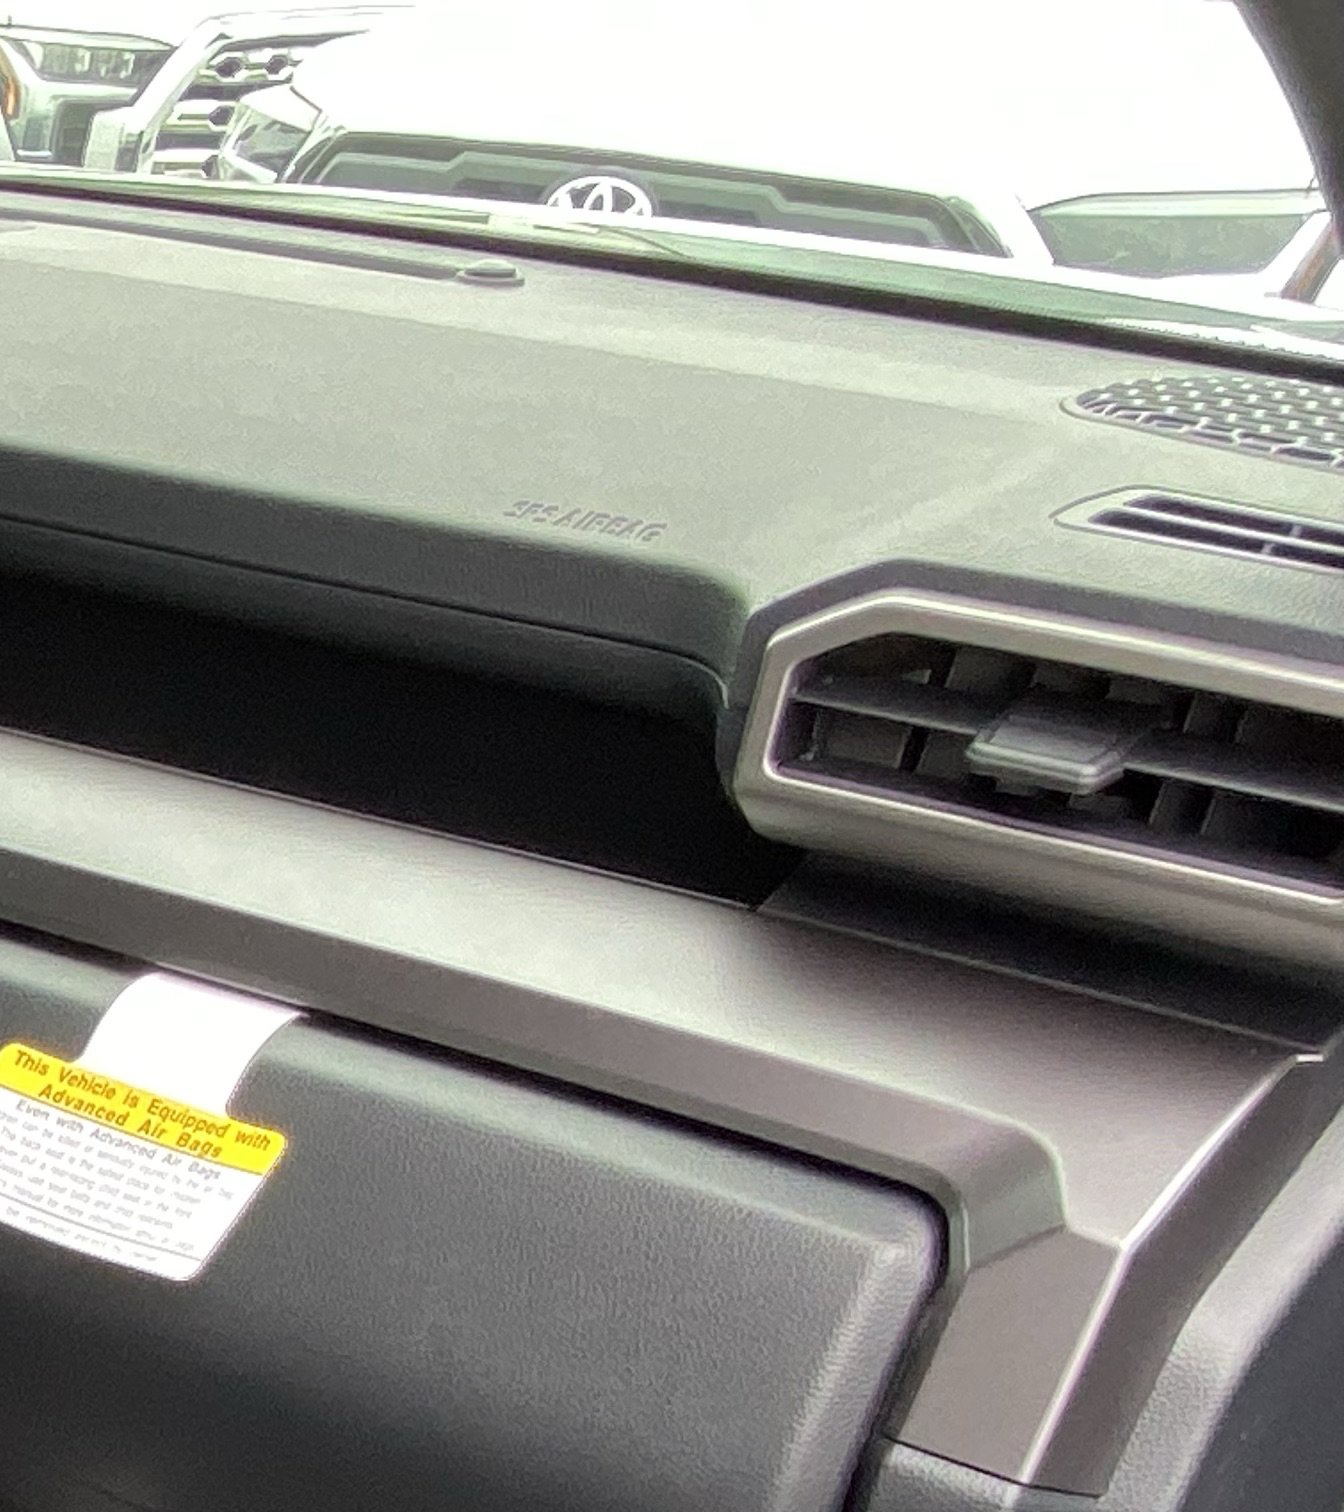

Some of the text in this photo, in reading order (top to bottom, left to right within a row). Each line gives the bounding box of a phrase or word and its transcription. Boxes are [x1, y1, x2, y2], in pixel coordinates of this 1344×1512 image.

[502, 499, 668, 543] SRS AIRBAG
[14, 1049, 51, 1076] This
[58, 1066, 116, 1101] Vehicle
[147, 1098, 231, 1138] Equipped
[234, 1129, 271, 1151] with
[16, 1098, 222, 1180] Even with Advanced Air Bags
[38, 1083, 223, 1159] Advanced Air Bags
